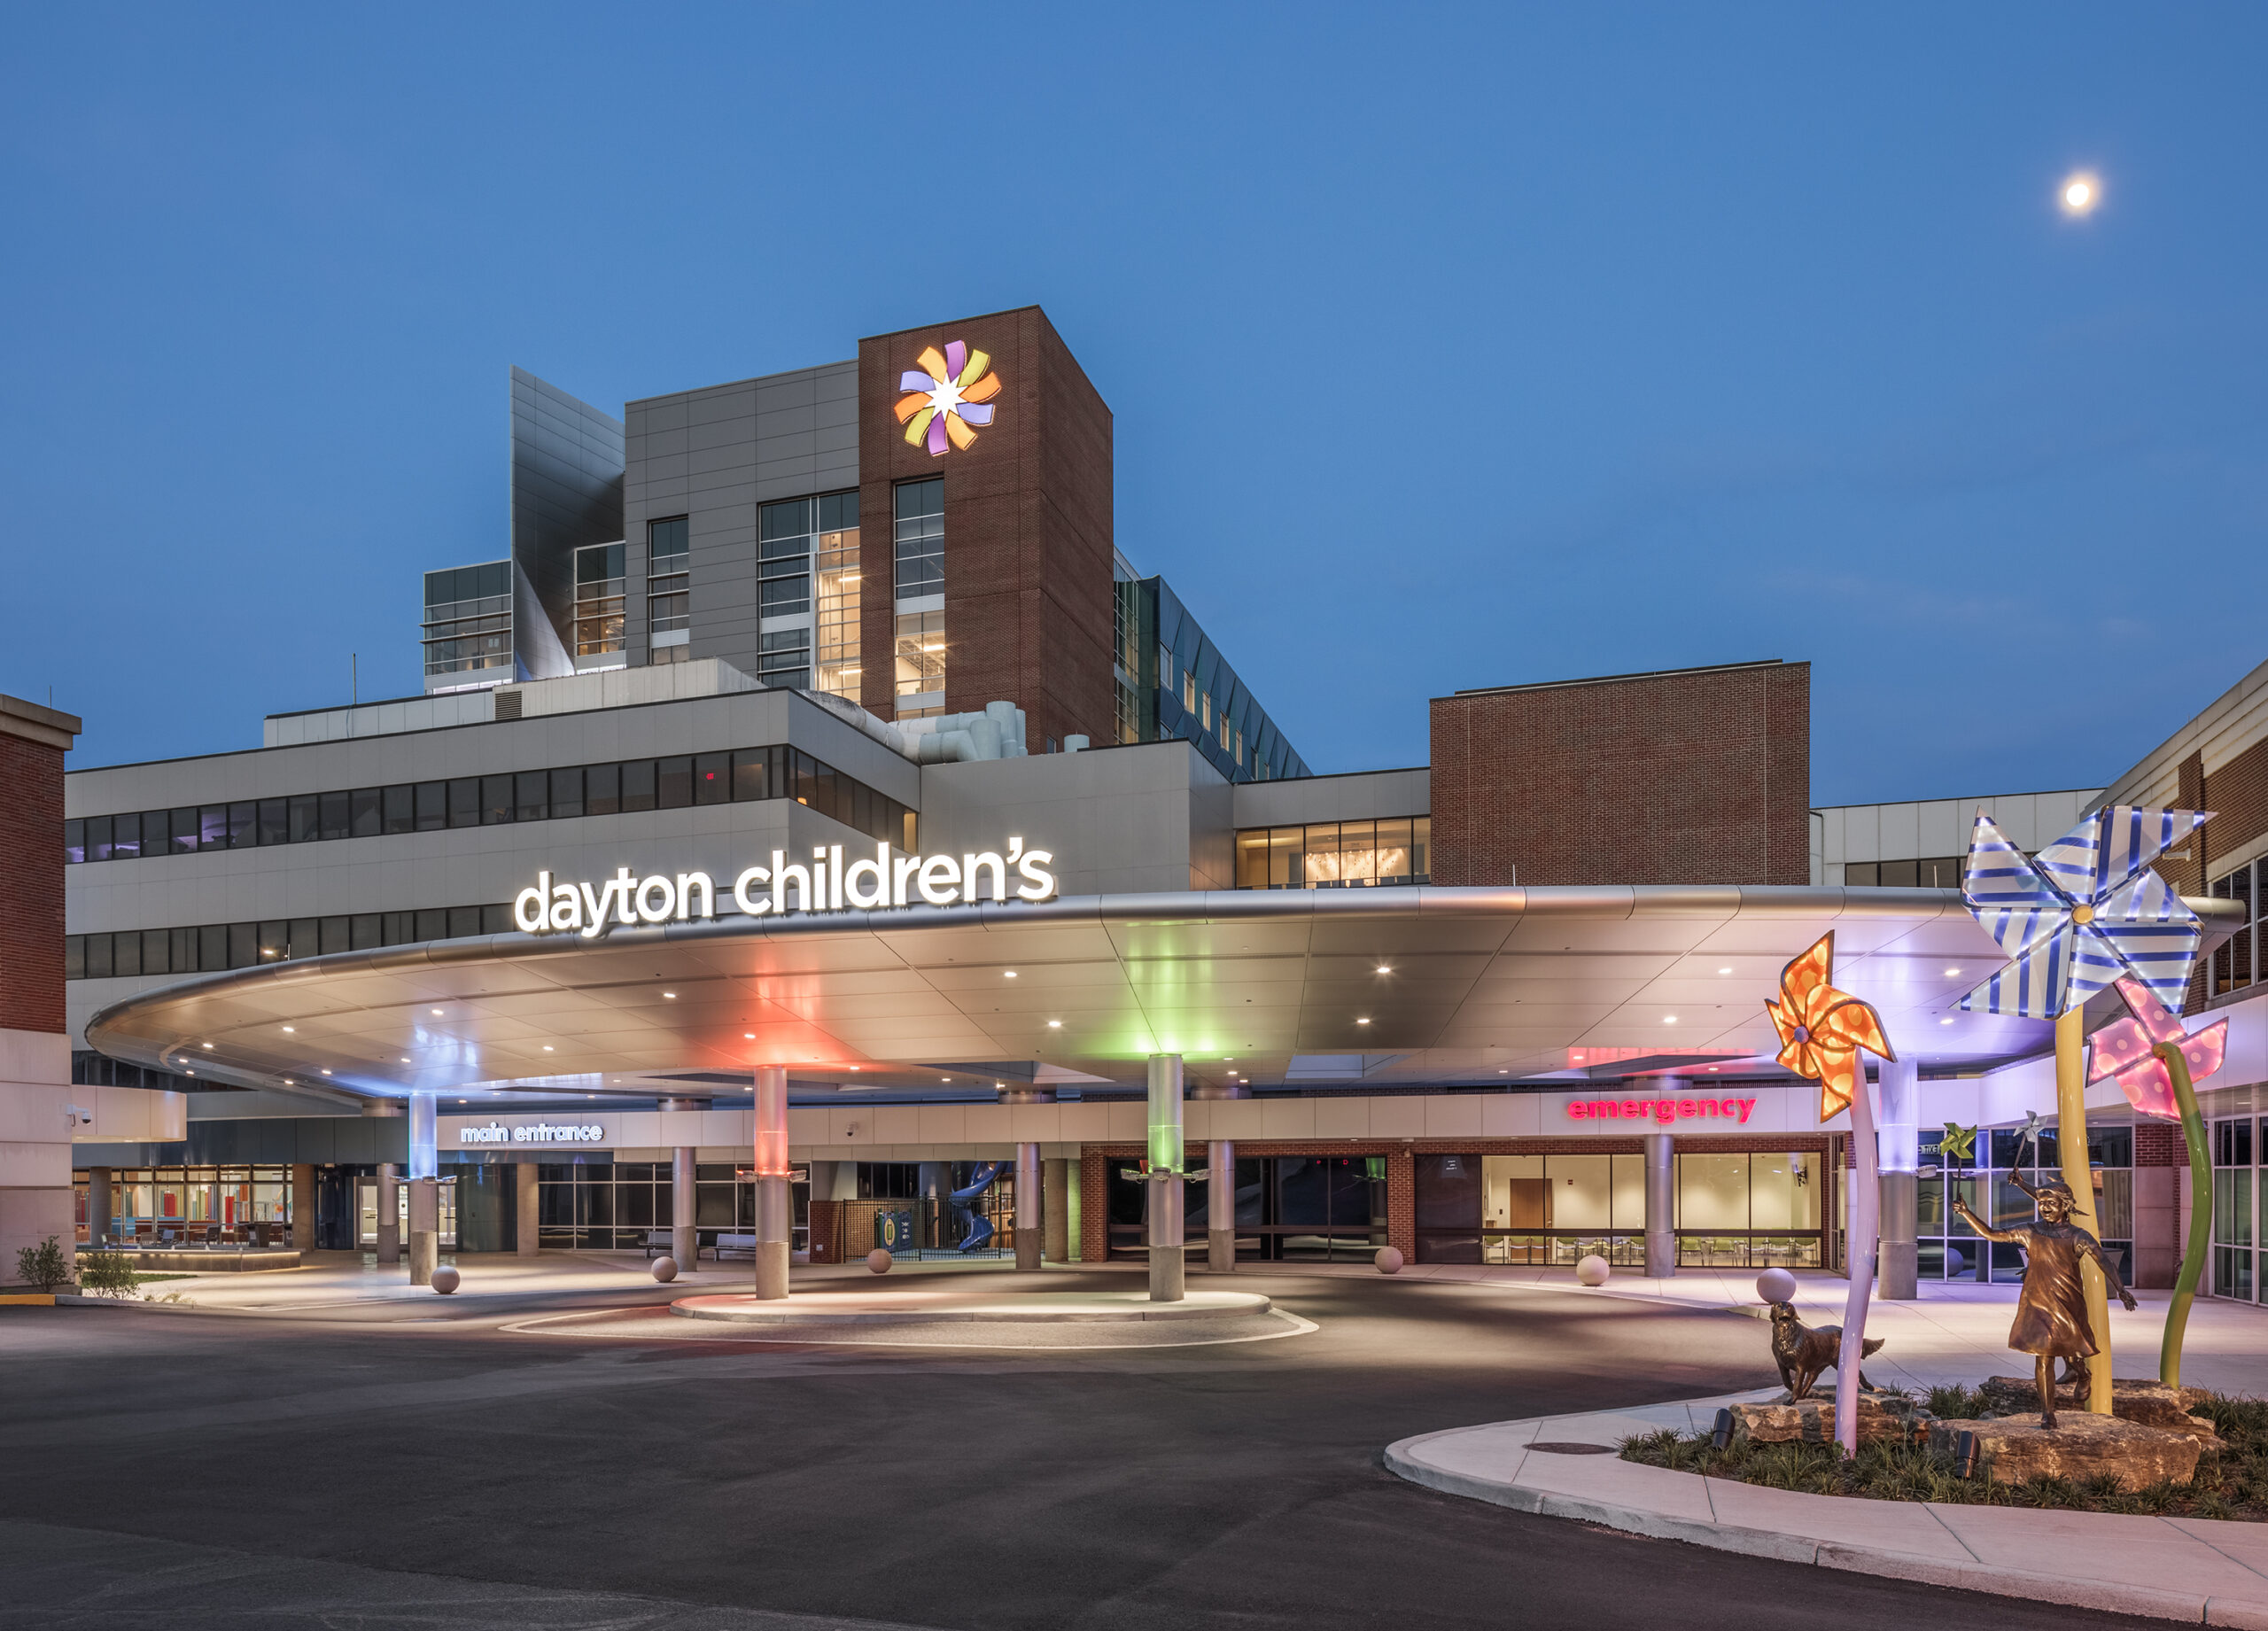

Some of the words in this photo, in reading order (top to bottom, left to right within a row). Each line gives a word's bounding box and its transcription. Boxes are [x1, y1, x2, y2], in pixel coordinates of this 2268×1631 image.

[514, 870, 714, 939] dayton
[734, 836, 1056, 916] children's
[1567, 1098, 1758, 1124] emergency
[461, 1122, 509, 1142] main
[514, 1123, 604, 1141] entrance
